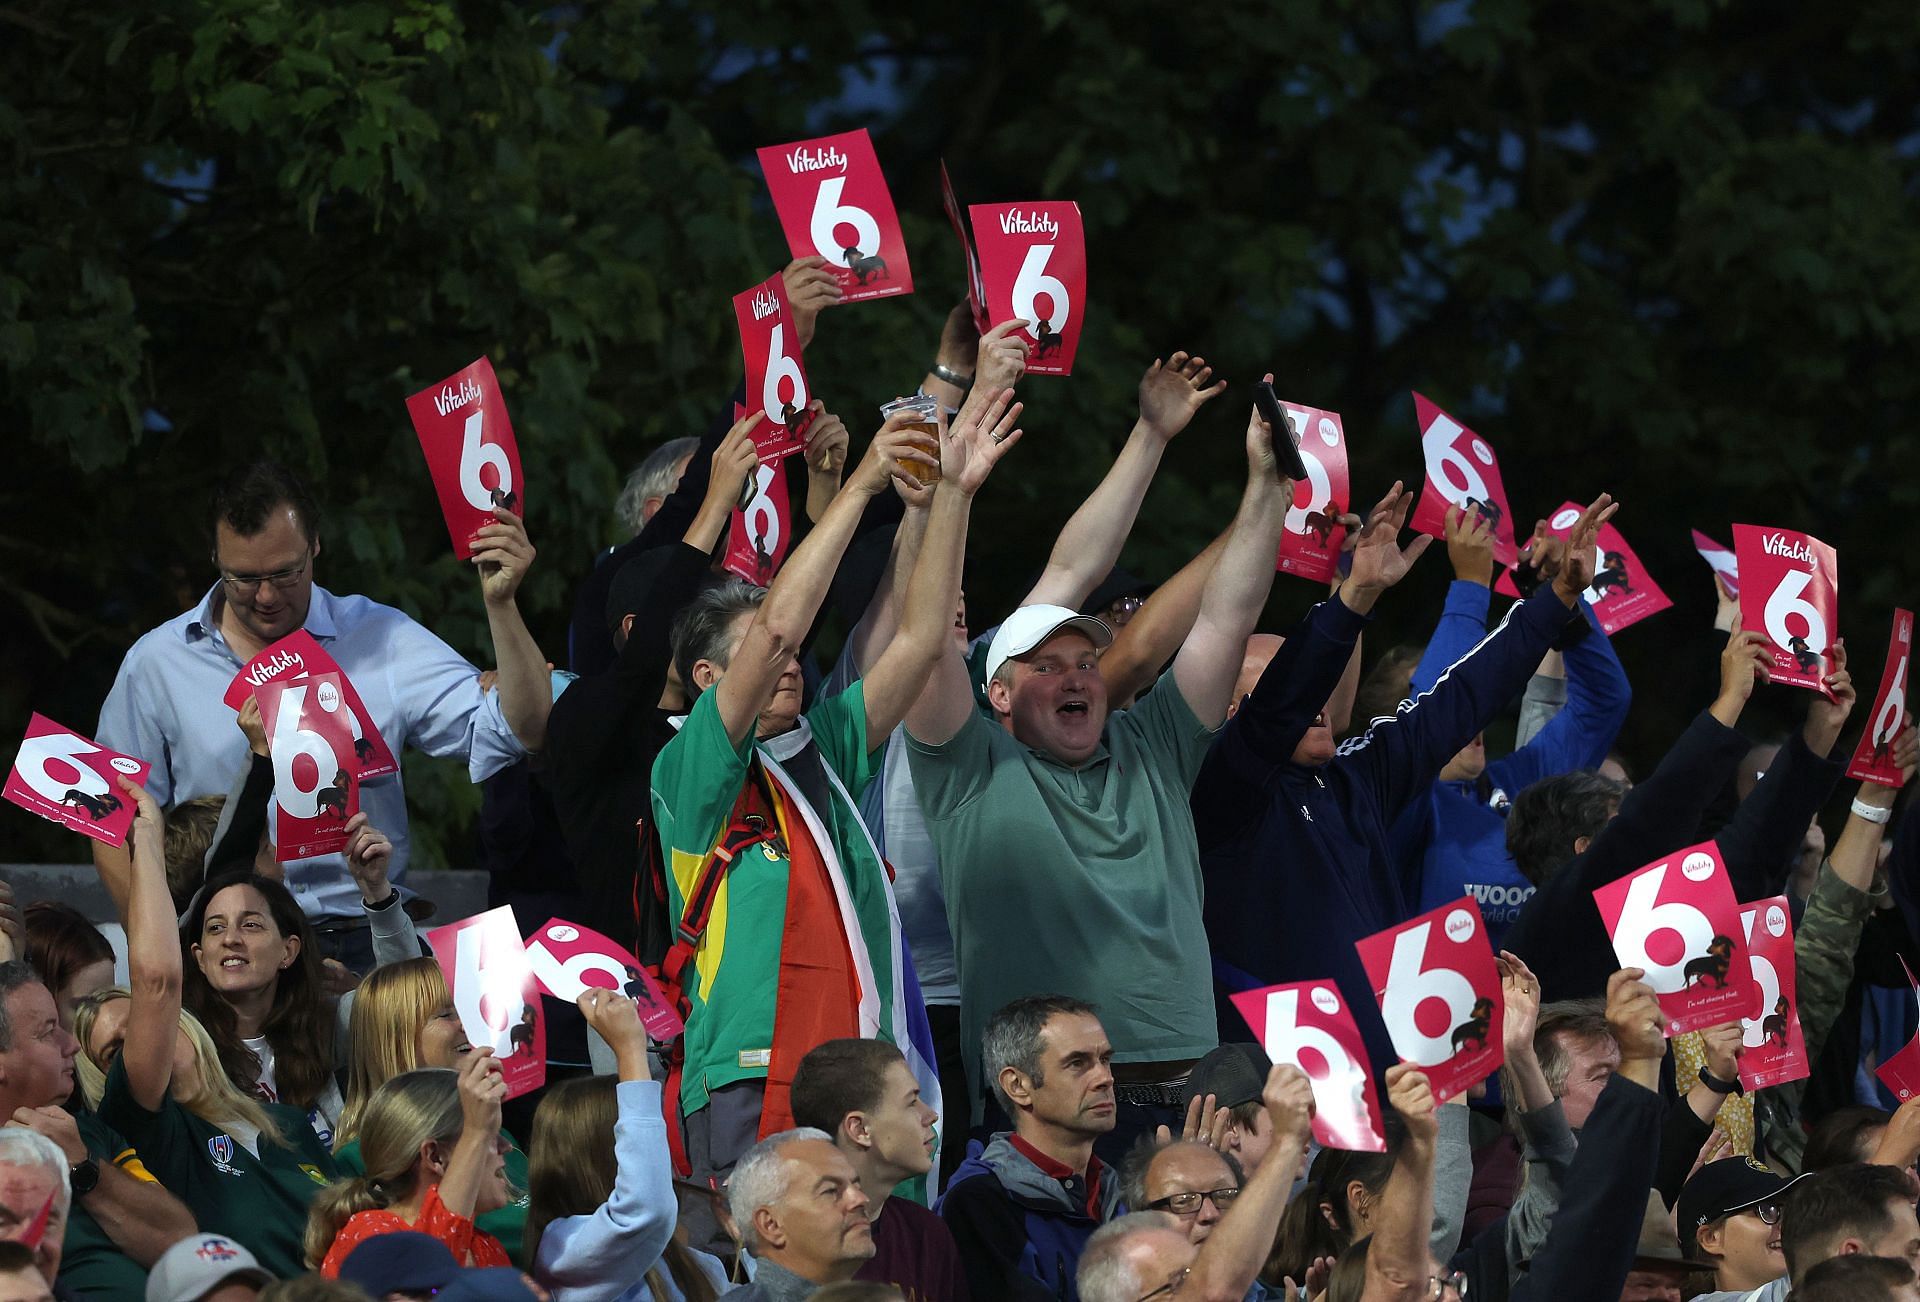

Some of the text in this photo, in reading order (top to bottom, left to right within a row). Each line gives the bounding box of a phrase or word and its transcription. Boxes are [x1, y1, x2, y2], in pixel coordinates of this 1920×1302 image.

[787, 147, 847, 174] Vitality
[810, 176, 881, 268] 6
[1000, 208, 1059, 241] Vitality
[751, 290, 781, 321] Vitality
[1012, 244, 1070, 340] 6
[434, 379, 482, 416] Vitality
[763, 322, 807, 425] 6
[460, 409, 512, 512] 6
[1422, 413, 1490, 512] 6
[744, 464, 780, 557] 6
[1762, 532, 1818, 571] Vitality
[1764, 569, 1827, 655] 6
[245, 650, 305, 686] Vitality
[1872, 656, 1907, 749] 6
[14, 733, 110, 808] 6
[272, 685, 339, 819] 6
[1685, 860, 1711, 874] Vitality
[525, 939, 637, 1005] 6
[1612, 863, 1716, 994] 6
[454, 923, 525, 1059] 6
[1381, 921, 1478, 1067] 6
[1265, 989, 1355, 1118] 6
